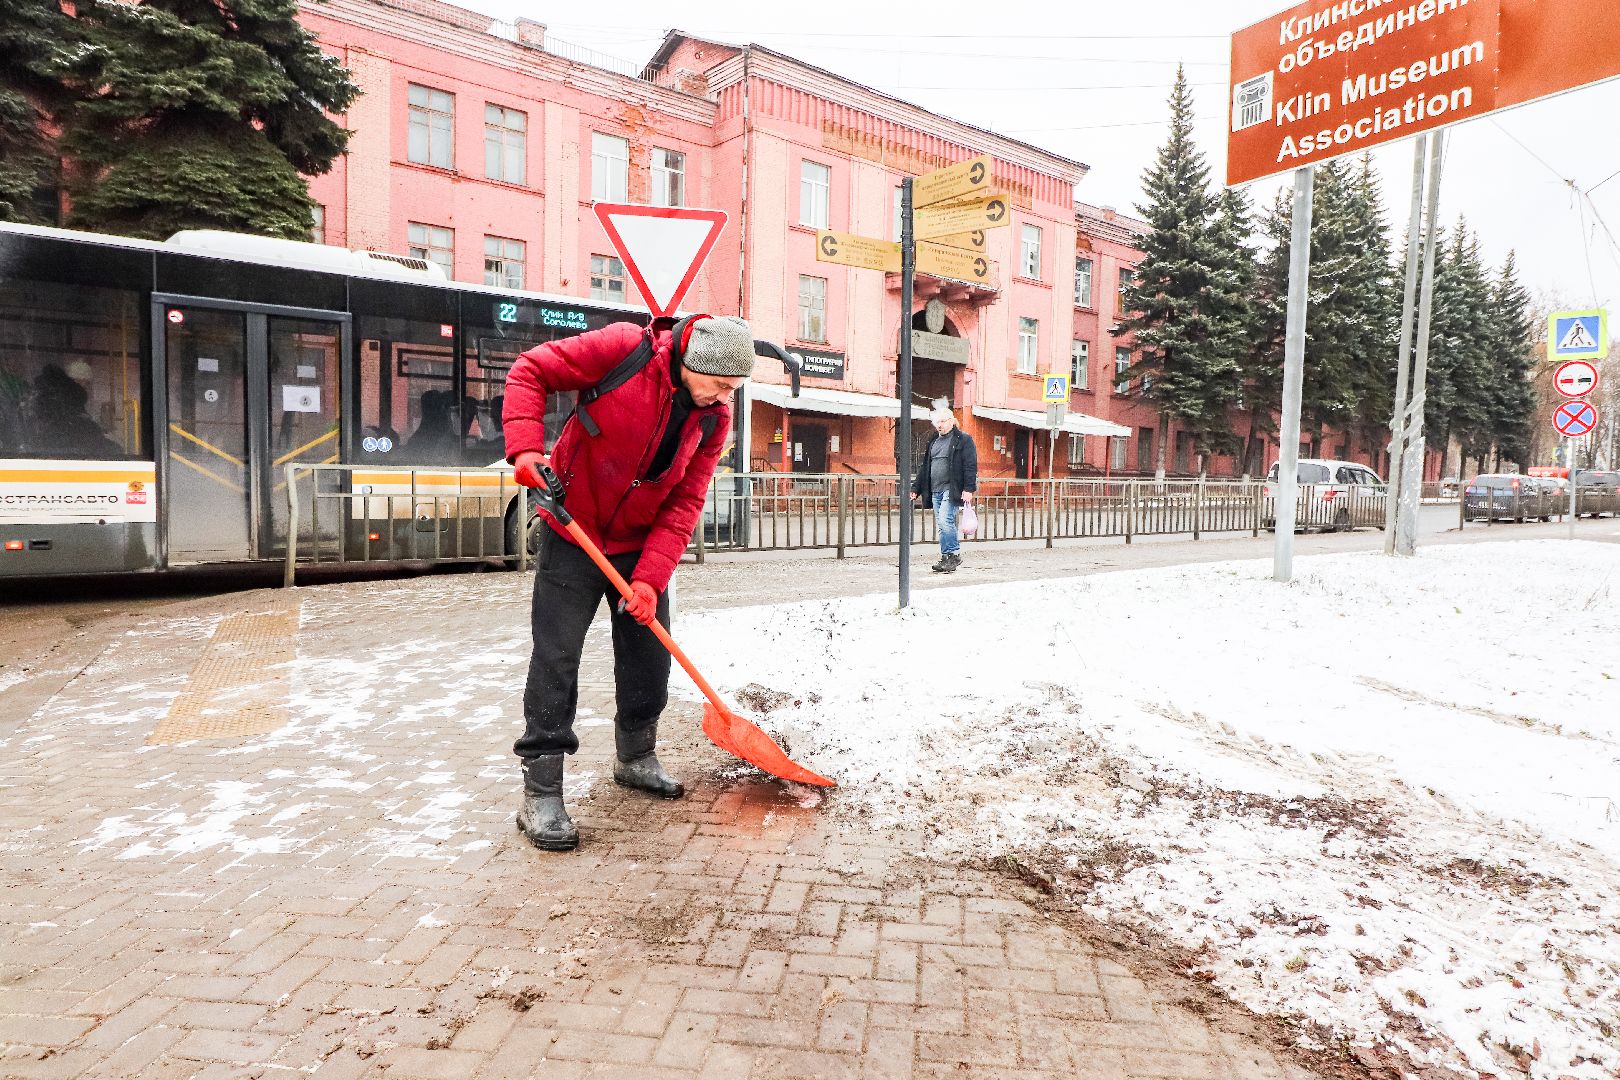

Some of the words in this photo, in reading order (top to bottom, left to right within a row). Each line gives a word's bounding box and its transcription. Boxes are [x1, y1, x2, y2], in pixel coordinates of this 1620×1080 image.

[1278, 0, 1476, 73] объединен
[1276, 91, 1330, 126] Klin
[1341, 40, 1484, 106] Museum
[1276, 86, 1472, 163] Association
[500, 303, 516, 322] 22
[541, 308, 564, 319] Клин
[543, 317, 587, 329] Соголево
[0, 495, 118, 503] СТРАНСАВТО
